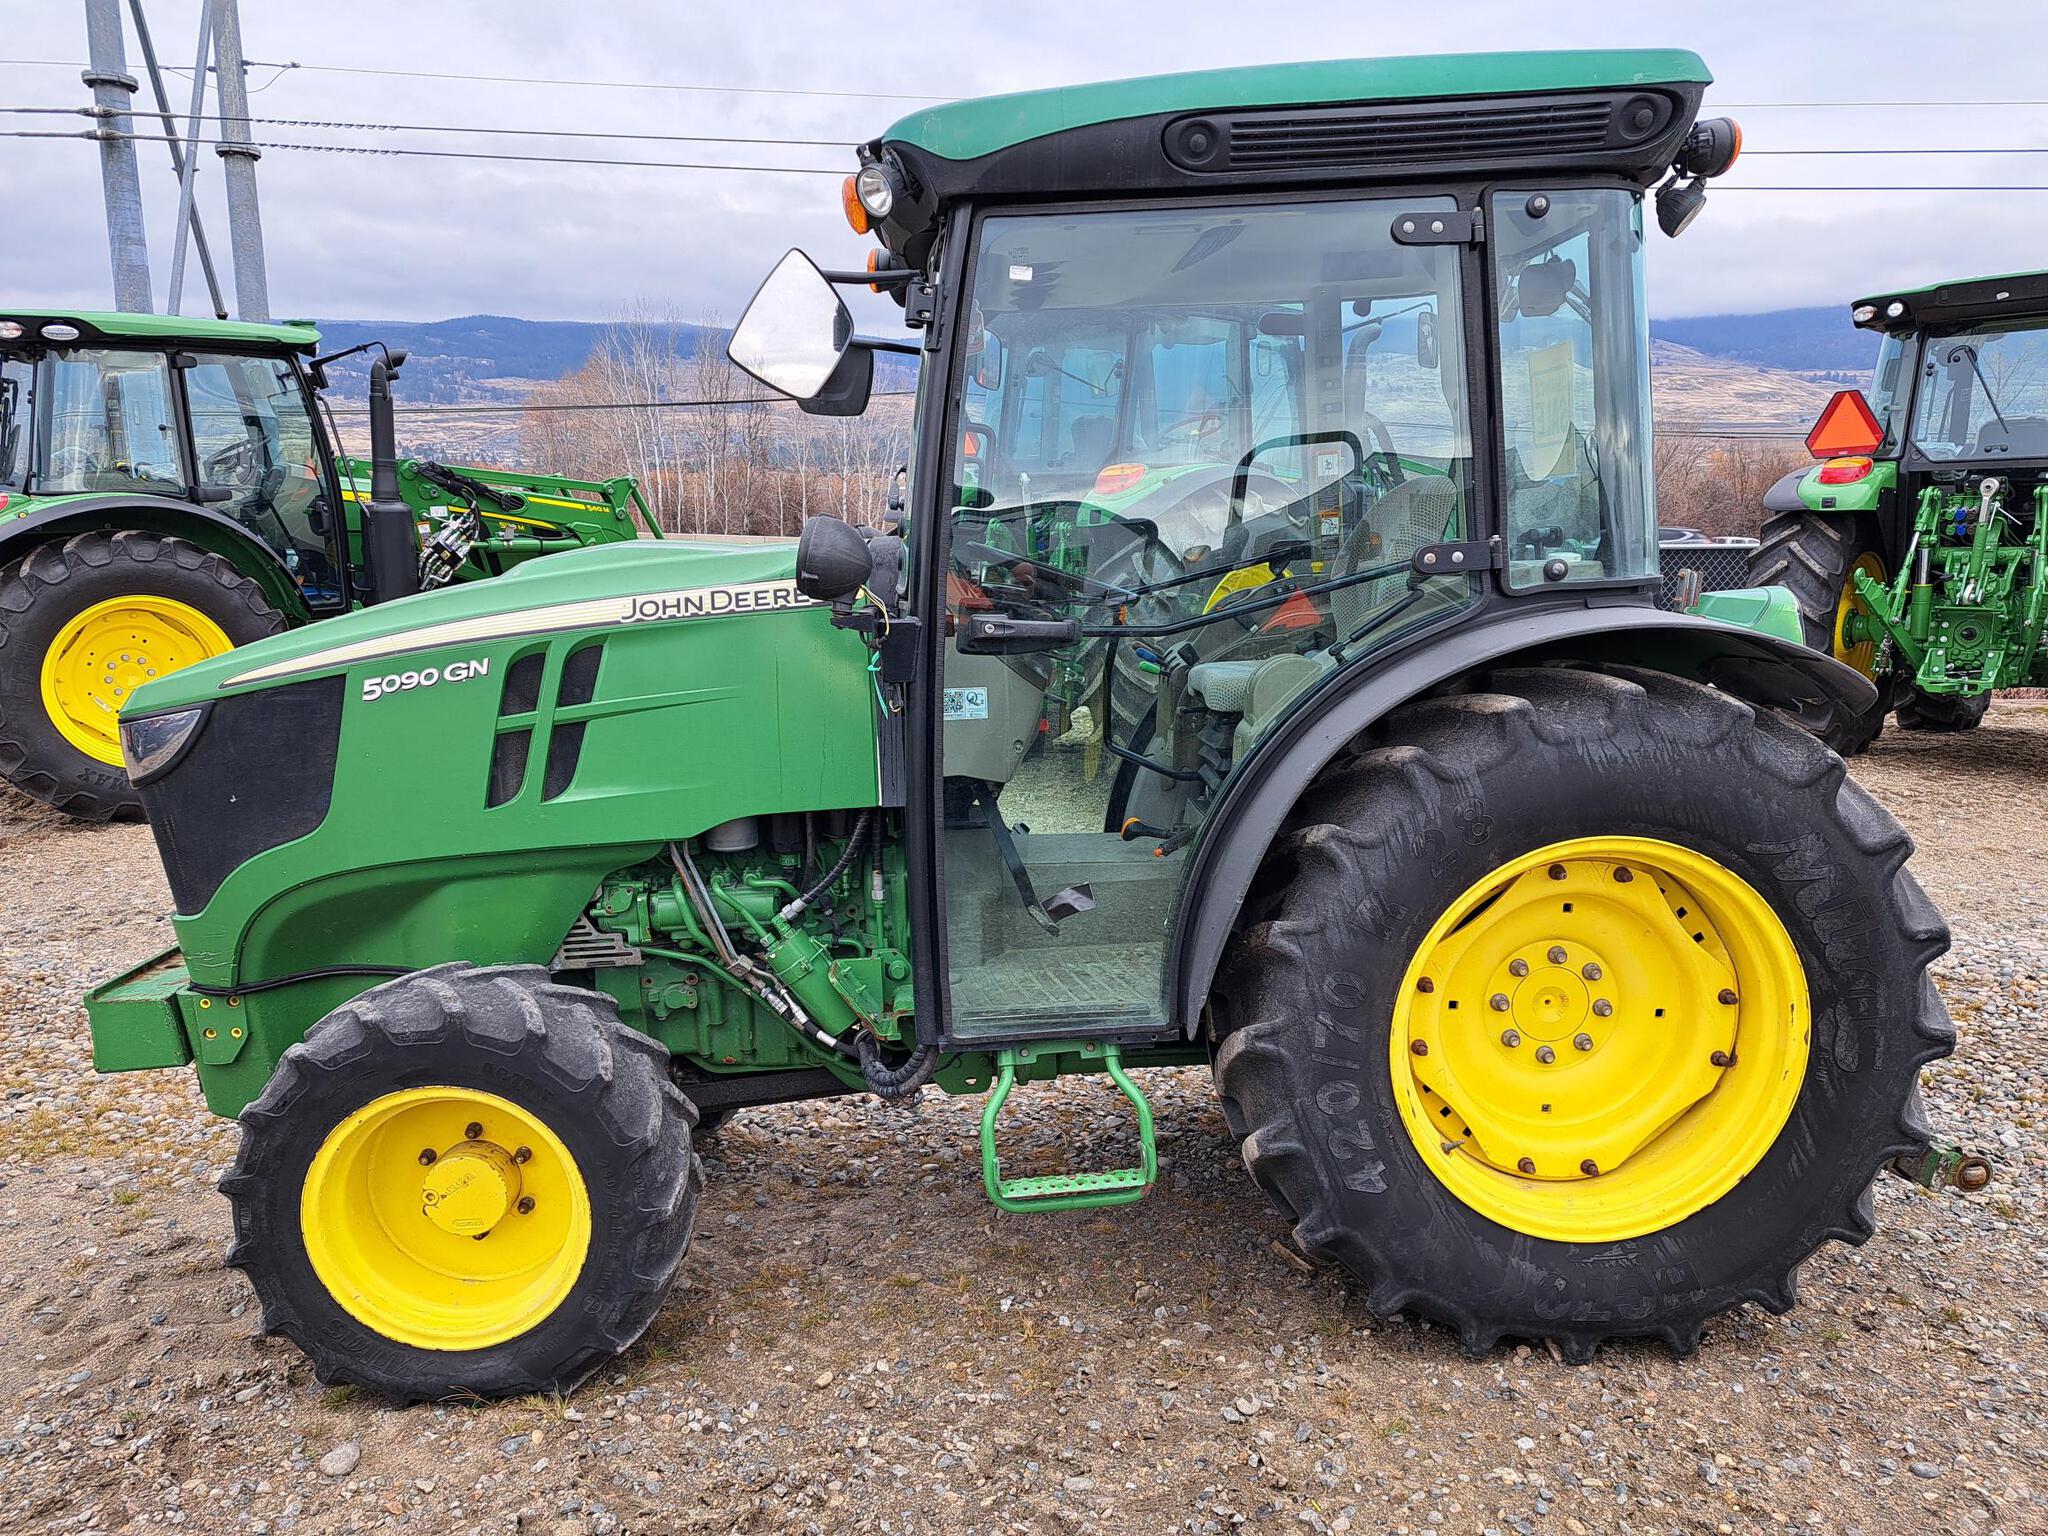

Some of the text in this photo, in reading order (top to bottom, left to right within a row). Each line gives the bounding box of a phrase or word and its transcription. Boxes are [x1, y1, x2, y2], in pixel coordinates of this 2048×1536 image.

[362, 657, 490, 702] 5090 GN
[621, 595, 704, 621] JOHN
[1311, 797, 1496, 1194] 420/70 R 28
[1745, 832, 1889, 1073] Mitas
